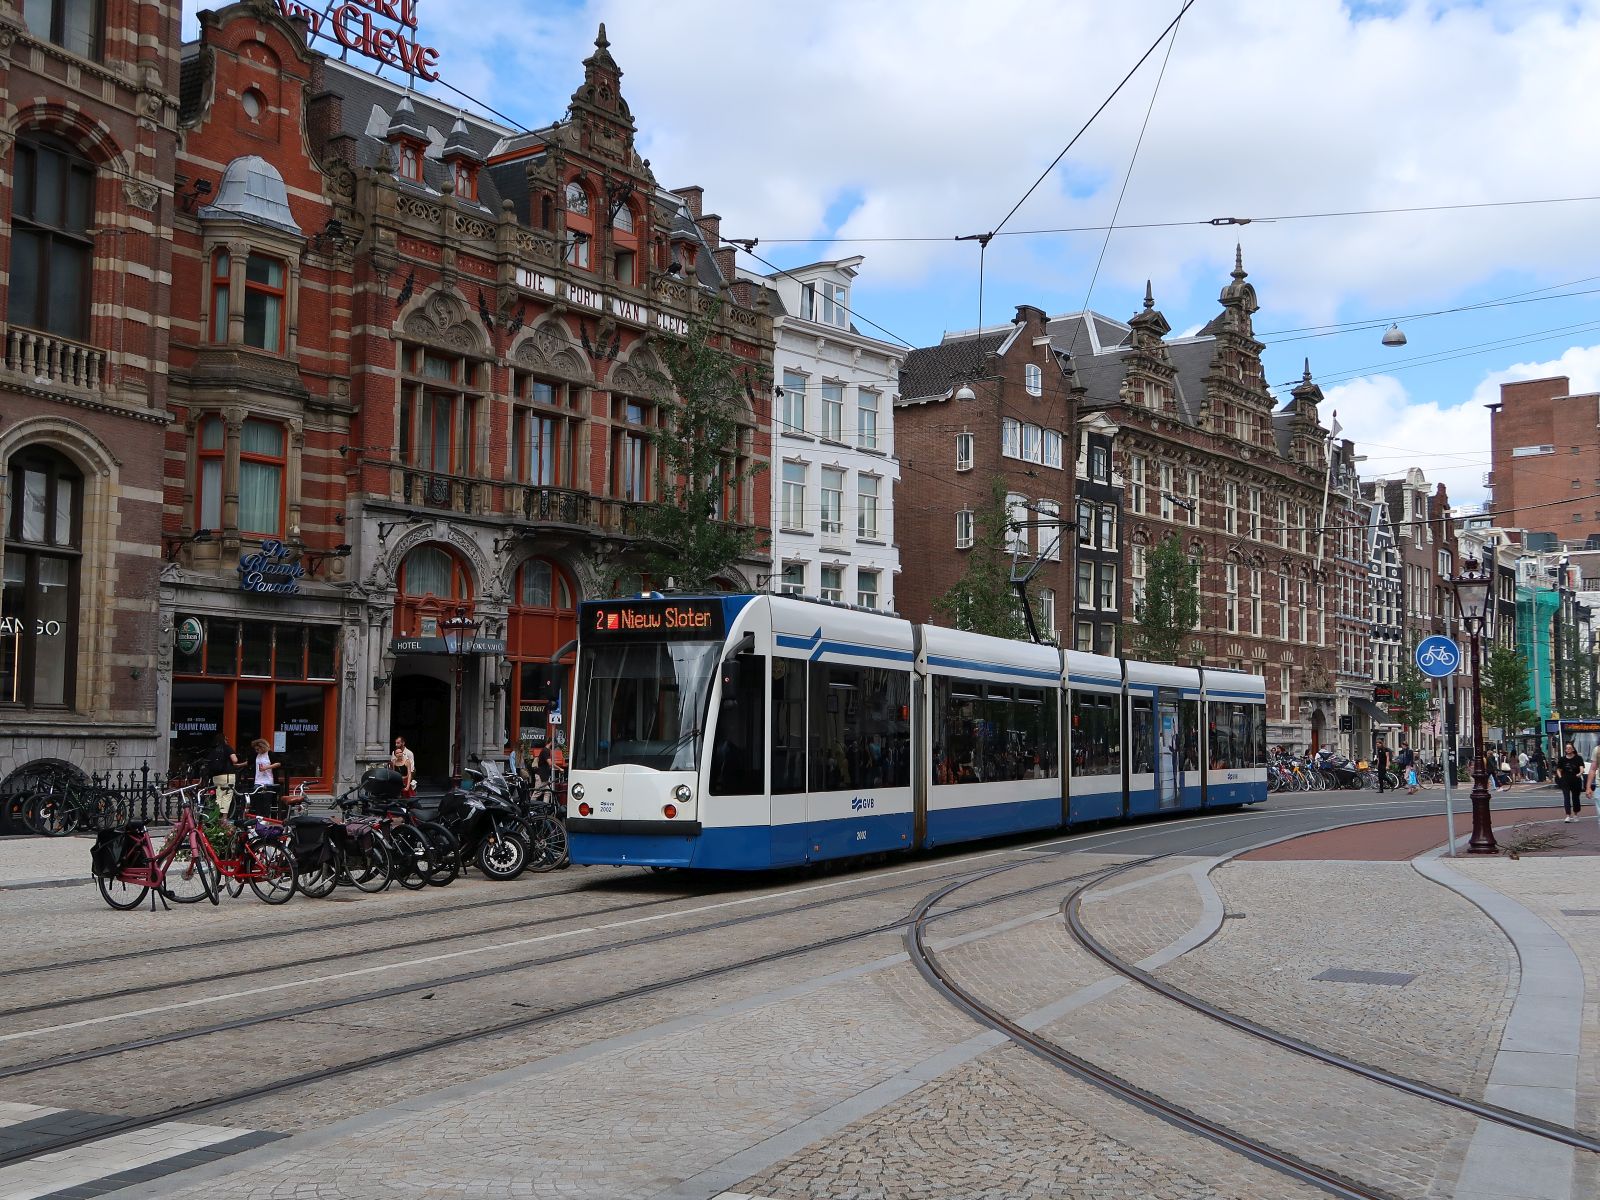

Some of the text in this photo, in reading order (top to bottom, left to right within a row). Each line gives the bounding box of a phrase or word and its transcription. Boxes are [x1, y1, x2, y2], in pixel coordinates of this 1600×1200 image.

[525, 271, 545, 292] DIE
[570, 285, 598, 309] PORT
[619, 301, 640, 322] VAN
[243, 571, 301, 594] Parade
[596, 610, 604, 630] 2
[621, 609, 661, 629] Nieuw
[397, 641, 421, 650] HOTEL
[862, 798, 875, 809] GVB
